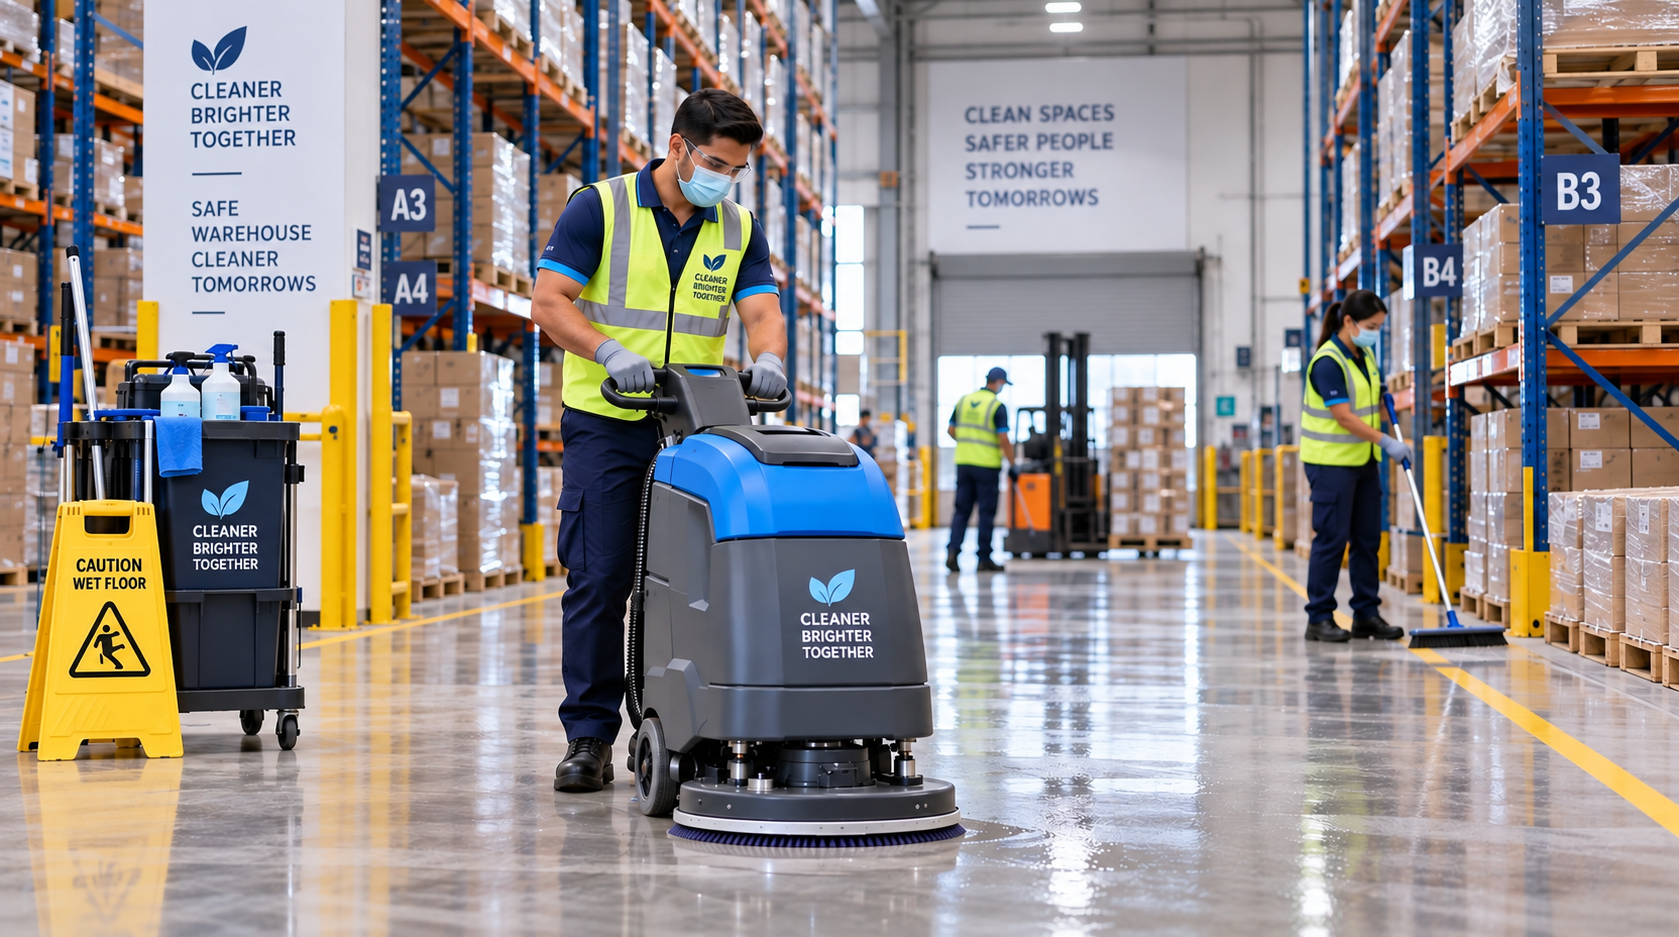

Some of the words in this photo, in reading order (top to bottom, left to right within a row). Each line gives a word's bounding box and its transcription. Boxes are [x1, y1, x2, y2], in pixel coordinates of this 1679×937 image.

[191, 81, 282, 99] CLEANER
[191, 105, 290, 124] BRIGHTER
[964, 106, 1032, 124] CLEAN
[1039, 104, 1115, 123] SPACES
[190, 130, 296, 148] TOGETHER
[965, 134, 1029, 152] SAFER
[1036, 132, 1114, 151] PEOPLE
[965, 161, 1075, 180] STRONGER
[965, 189, 1099, 208] TOMORROWS
[1557, 172, 1602, 211] B3
[191, 200, 239, 217] SAFE
[391, 188, 427, 221] A3
[191, 225, 312, 243] WAREHOUSE
[191, 251, 279, 268] CLEANER
[694, 273, 728, 285] CLEANER
[1423, 256, 1457, 288] B4
[191, 275, 317, 293] TOMORROWS
[393, 273, 429, 306] A4
[193, 525, 258, 538] CLEANER
[193, 542, 258, 555] BRIGHTER
[76, 558, 142, 573] CAUTION
[193, 558, 259, 571] TOGETHER
[73, 577, 102, 590] WET
[105, 576, 147, 590] FLOOR
[800, 612, 870, 626] CLEANER
[801, 629, 873, 643] BRIGHTER
[802, 646, 874, 659] TOGETHER
